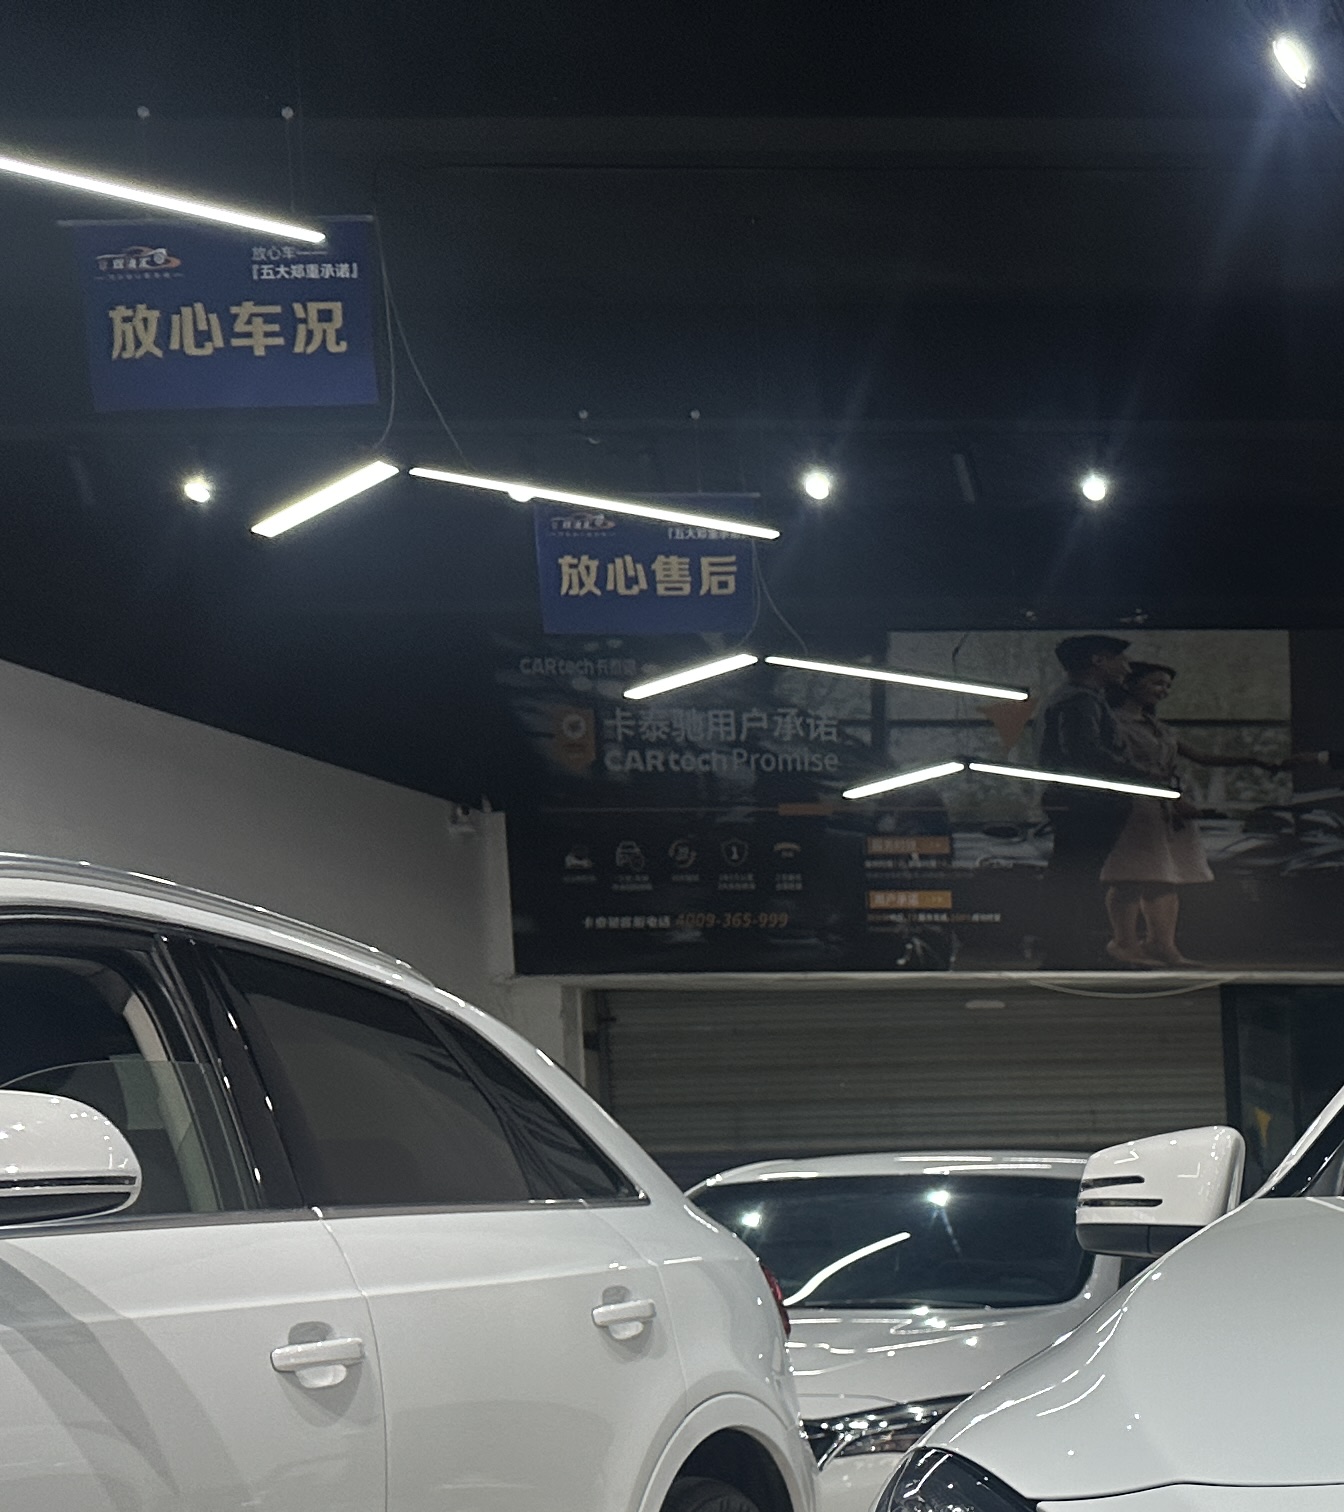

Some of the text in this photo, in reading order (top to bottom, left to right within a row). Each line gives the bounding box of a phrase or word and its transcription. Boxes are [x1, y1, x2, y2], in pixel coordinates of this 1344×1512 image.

[108, 300, 348, 360] 放心车况
[558, 554, 738, 597] 放心售后
[604, 707, 839, 744] 卡泰驰用户承诺
[734, 748, 840, 773] Promise
